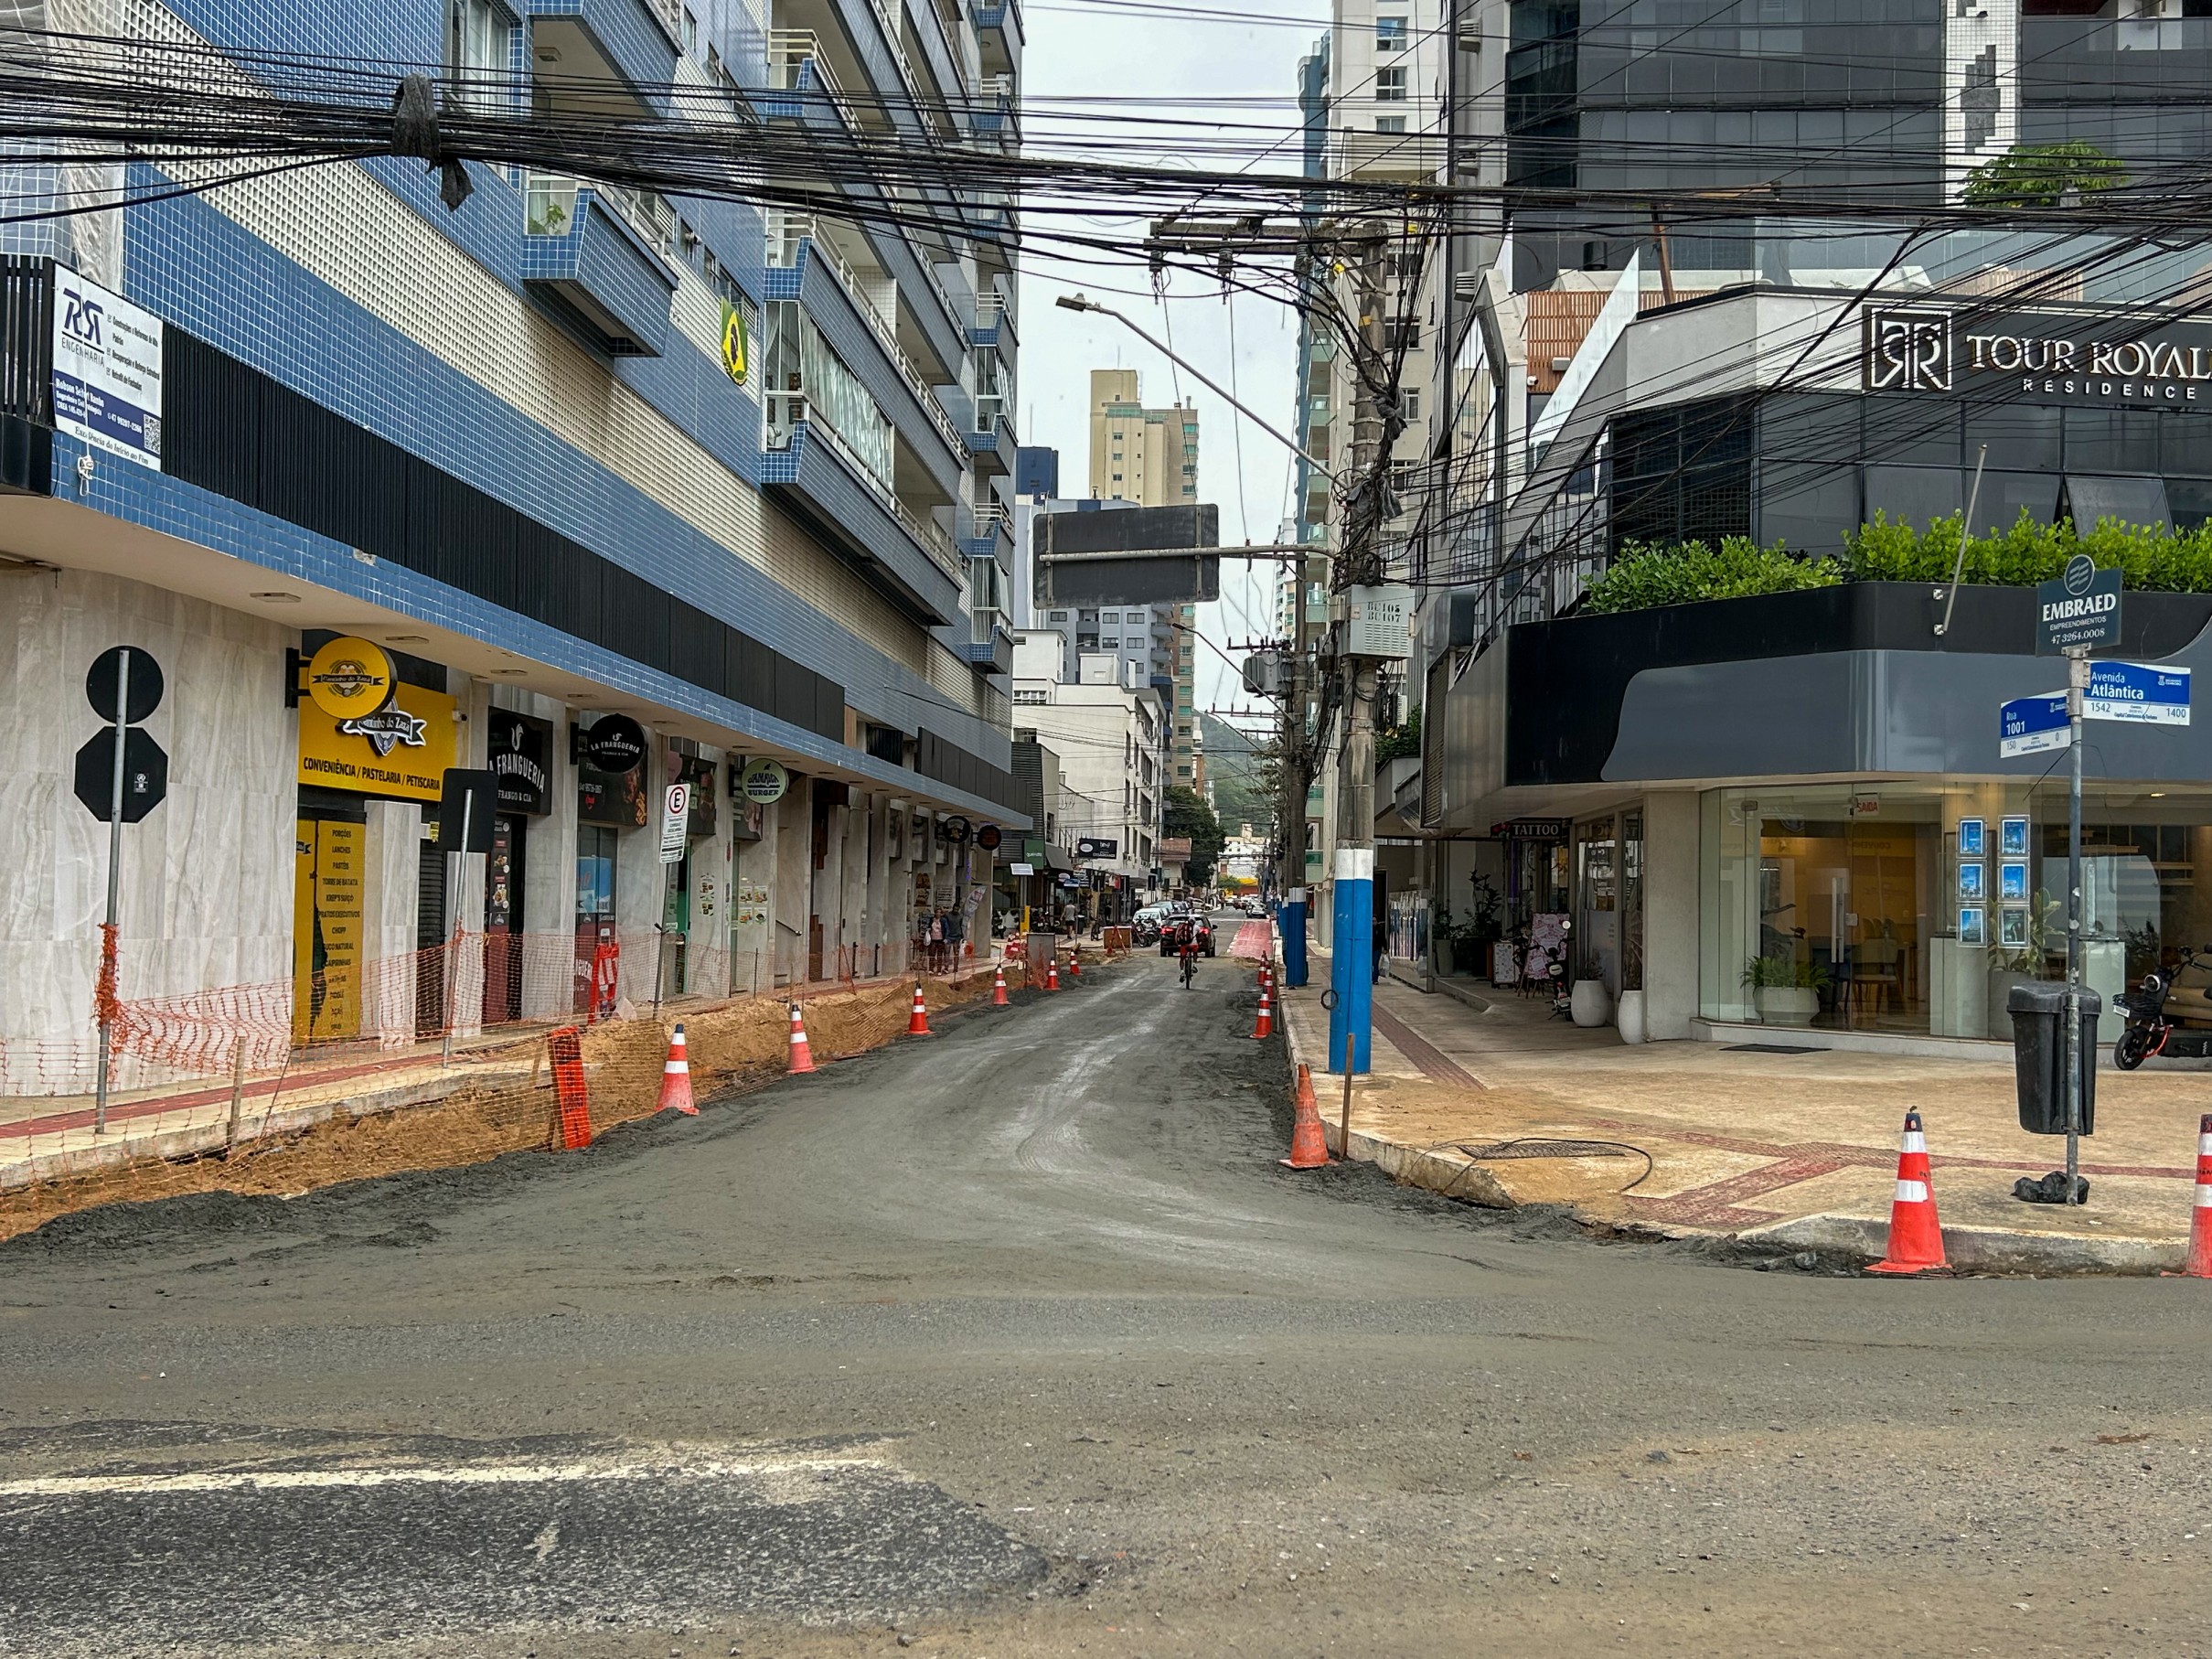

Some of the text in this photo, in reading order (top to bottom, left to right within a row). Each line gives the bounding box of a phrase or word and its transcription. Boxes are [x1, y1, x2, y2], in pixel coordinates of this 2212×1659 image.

[1966, 335, 2212, 380] TOUR ROYAL
[2023, 380, 2196, 400] RESIDENCE
[2042, 593, 2117, 622] EMBRAED
[2049, 615, 2107, 631] EMPREENDIMENTOS
[2091, 671, 2125, 683] Avenida
[2090, 683, 2144, 700] Atlântica
[2006, 712, 2017, 722] Rua
[2090, 701, 2186, 718] 1542 1400
[2005, 720, 2025, 735] 1001
[591, 742, 600, 751] LA
[304, 756, 356, 777] CONVENIÊNCIA
[362, 766, 401, 785] PASTELARIA
[406, 774, 441, 791] PETISCARIA
[497, 753, 545, 794] FRANGUERIA
[674, 792, 681, 808] E
[1513, 824, 1558, 835] TATTOO
